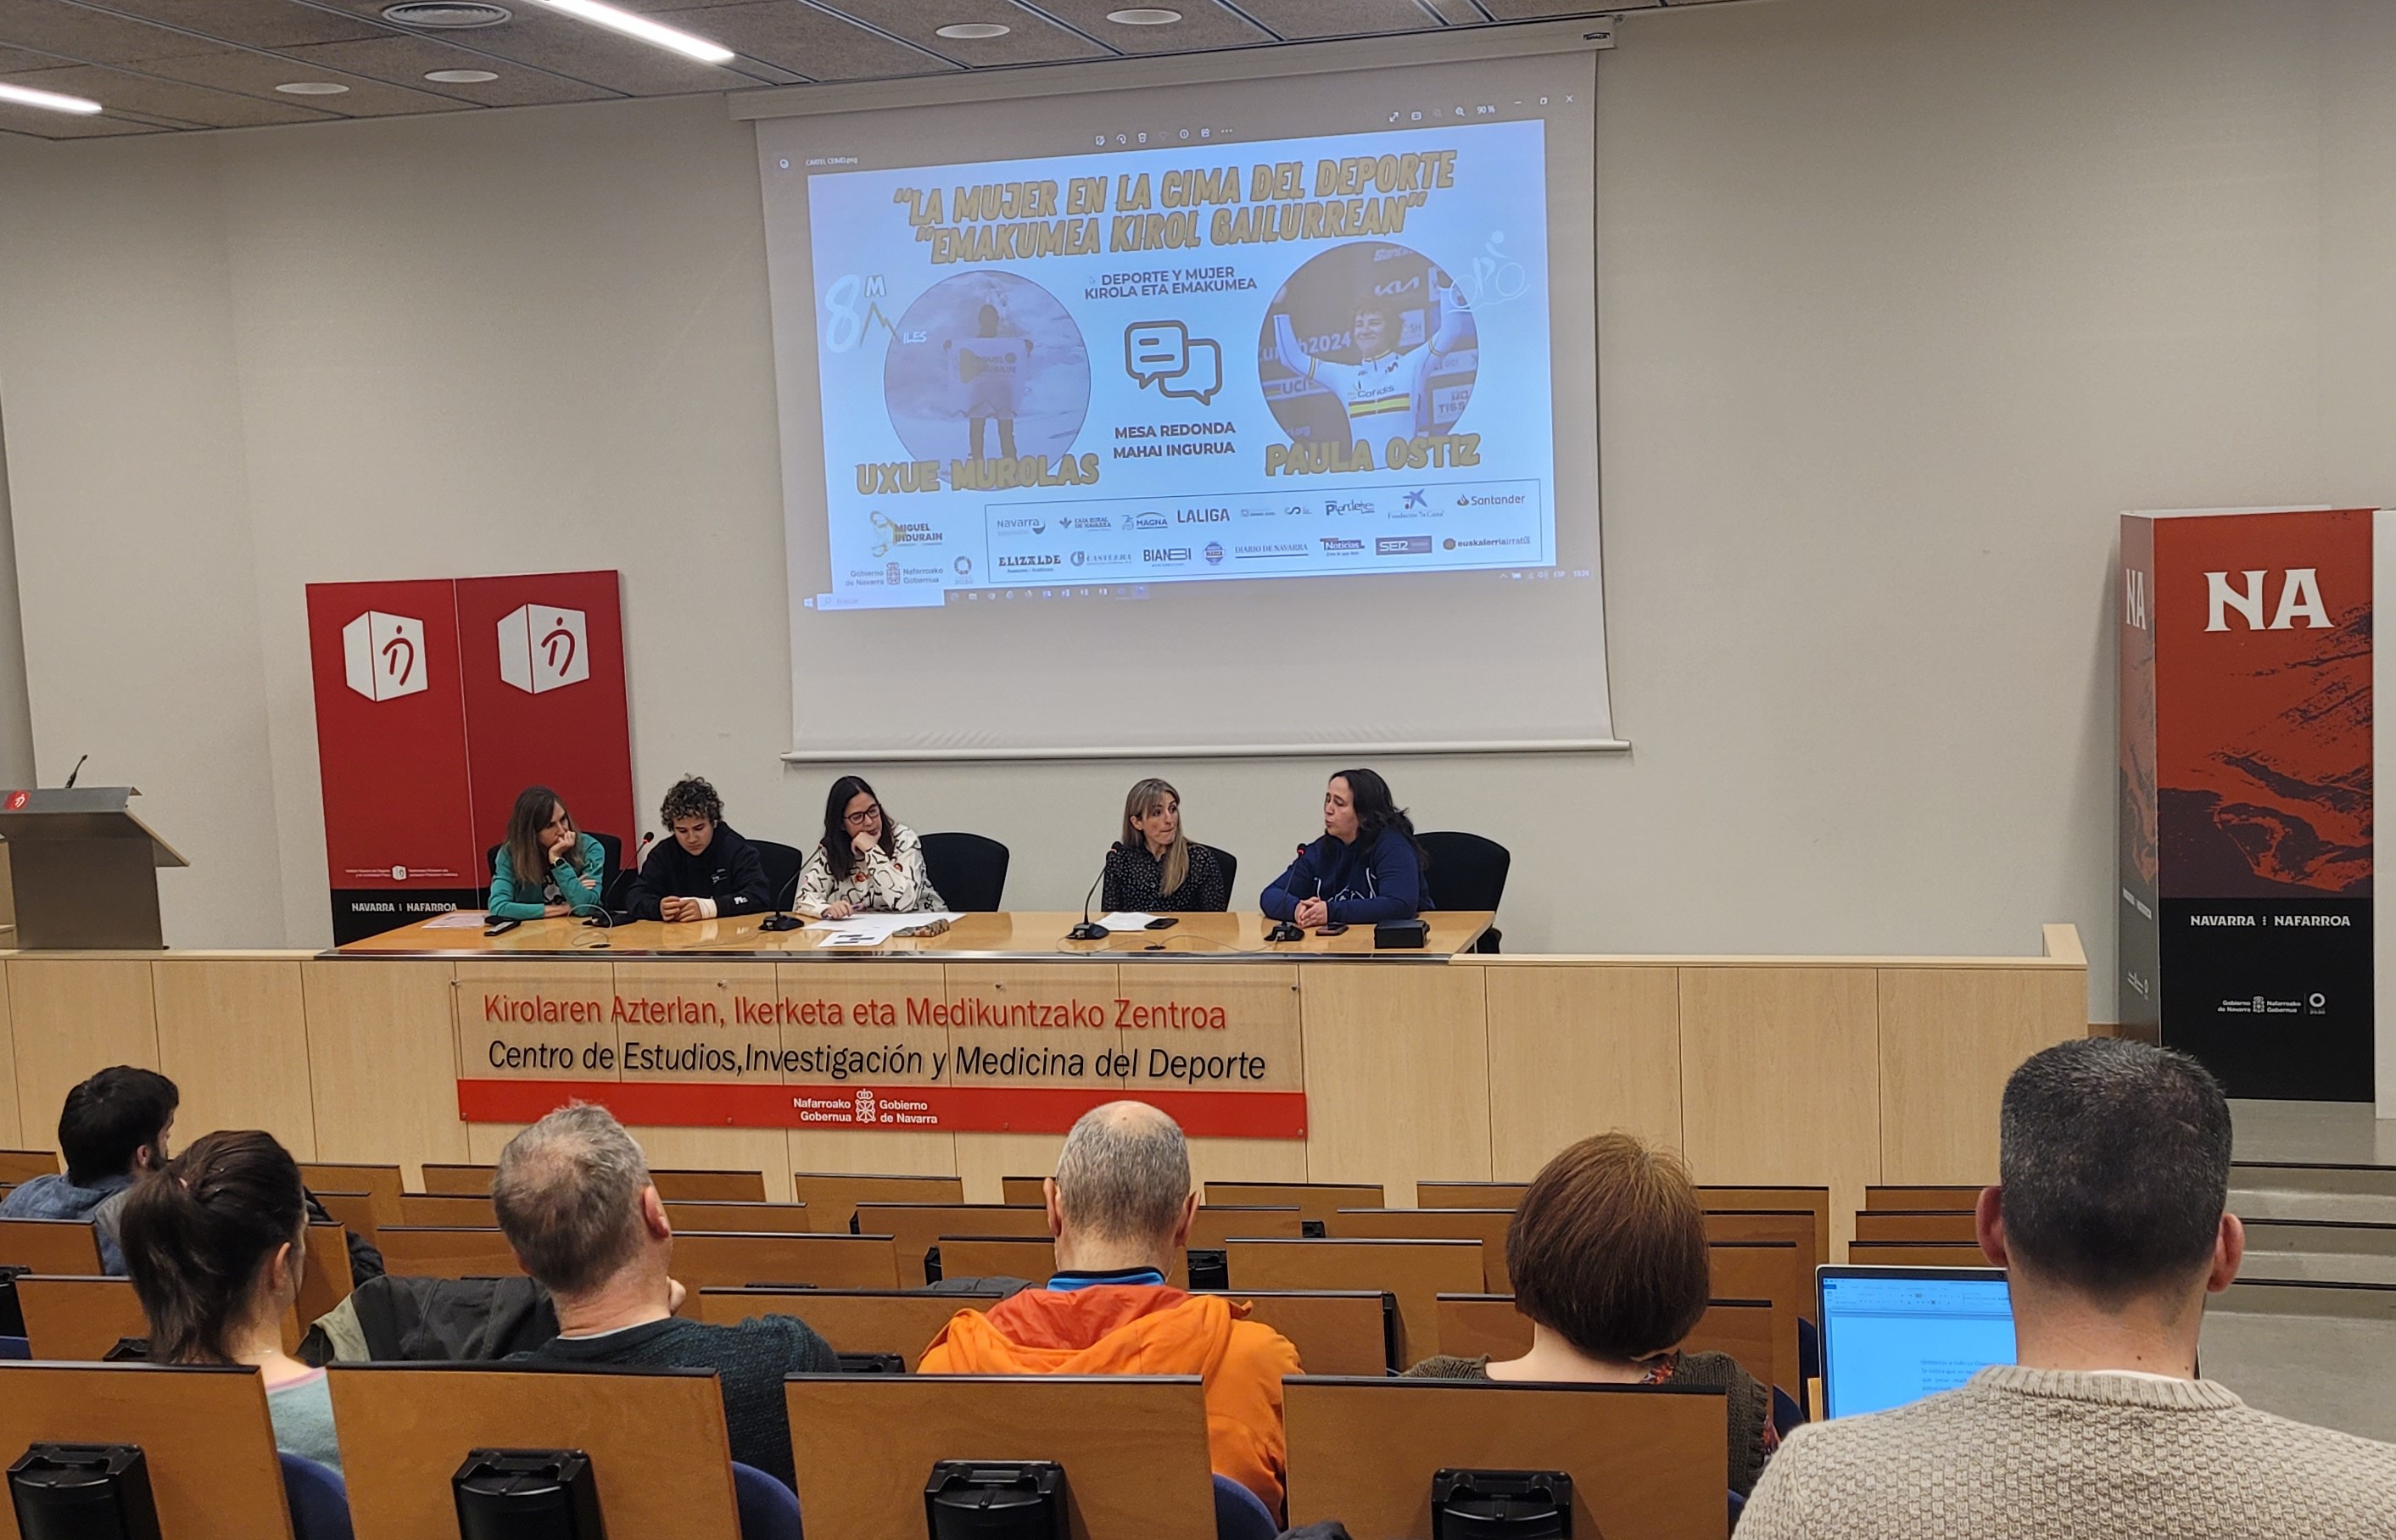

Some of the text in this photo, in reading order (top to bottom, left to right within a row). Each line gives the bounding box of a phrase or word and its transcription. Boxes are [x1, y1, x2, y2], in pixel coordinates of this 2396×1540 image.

[952, 180, 1058, 223] MUJER
[1066, 176, 1108, 215] EN
[1115, 172, 1151, 211] LA
[1160, 166, 1240, 208] CIMA
[1250, 161, 1304, 201] DEL
[1315, 149, 1457, 197] DEPORTE
[1109, 209, 1201, 252] KIROL
[1101, 266, 1235, 286] DEPORTE Y MUJER
[1085, 279, 1257, 300] KIROLA ETA EMAKUMEA
[1282, 381, 1307, 393] UCI
[1357, 384, 1394, 399] Cofidis
[1114, 421, 1236, 439] MESA REDONDA
[1113, 441, 1236, 459] MAHAI INGURUA
[1265, 433, 1481, 476] PAULA OSTIZ
[855, 452, 1100, 494] UXUE MUROLAS
[1471, 494, 1526, 505] Santander
[1177, 508, 1231, 523] LALIGA
[895, 523, 930, 533] MIGUEL
[997, 518, 1040, 527] Navarra
[895, 533, 943, 543] INDURAIN
[1235, 545, 1261, 554] DIARIO
[1273, 544, 1308, 552] NAVARRA
[1325, 541, 1360, 550] Noticias
[998, 555, 1061, 566] ELIZALDE
[2126, 569, 2147, 630] NA
[2203, 567, 2335, 632] NA
[351, 902, 457, 912] NAVARRA NAFARROA
[2190, 915, 2351, 927] NAVARRA NAFARROA
[483, 993, 1226, 1029] Kirolaren Azterlan, Ikerketa eta Medikuntzako Zentroa
[489, 1040, 573, 1069] Centro
[582, 1041, 615, 1069] de
[931, 1052, 947, 1081] y
[955, 1046, 1085, 1077] Medicina
[1095, 1048, 1137, 1078] del
[1148, 1048, 1266, 1085] Deporte
[794, 1098, 851, 1110] Nafarroako
[880, 1099, 928, 1111] Gobierno
[801, 1111, 852, 1123] Gobernua
[880, 1113, 938, 1124] de Navarra
